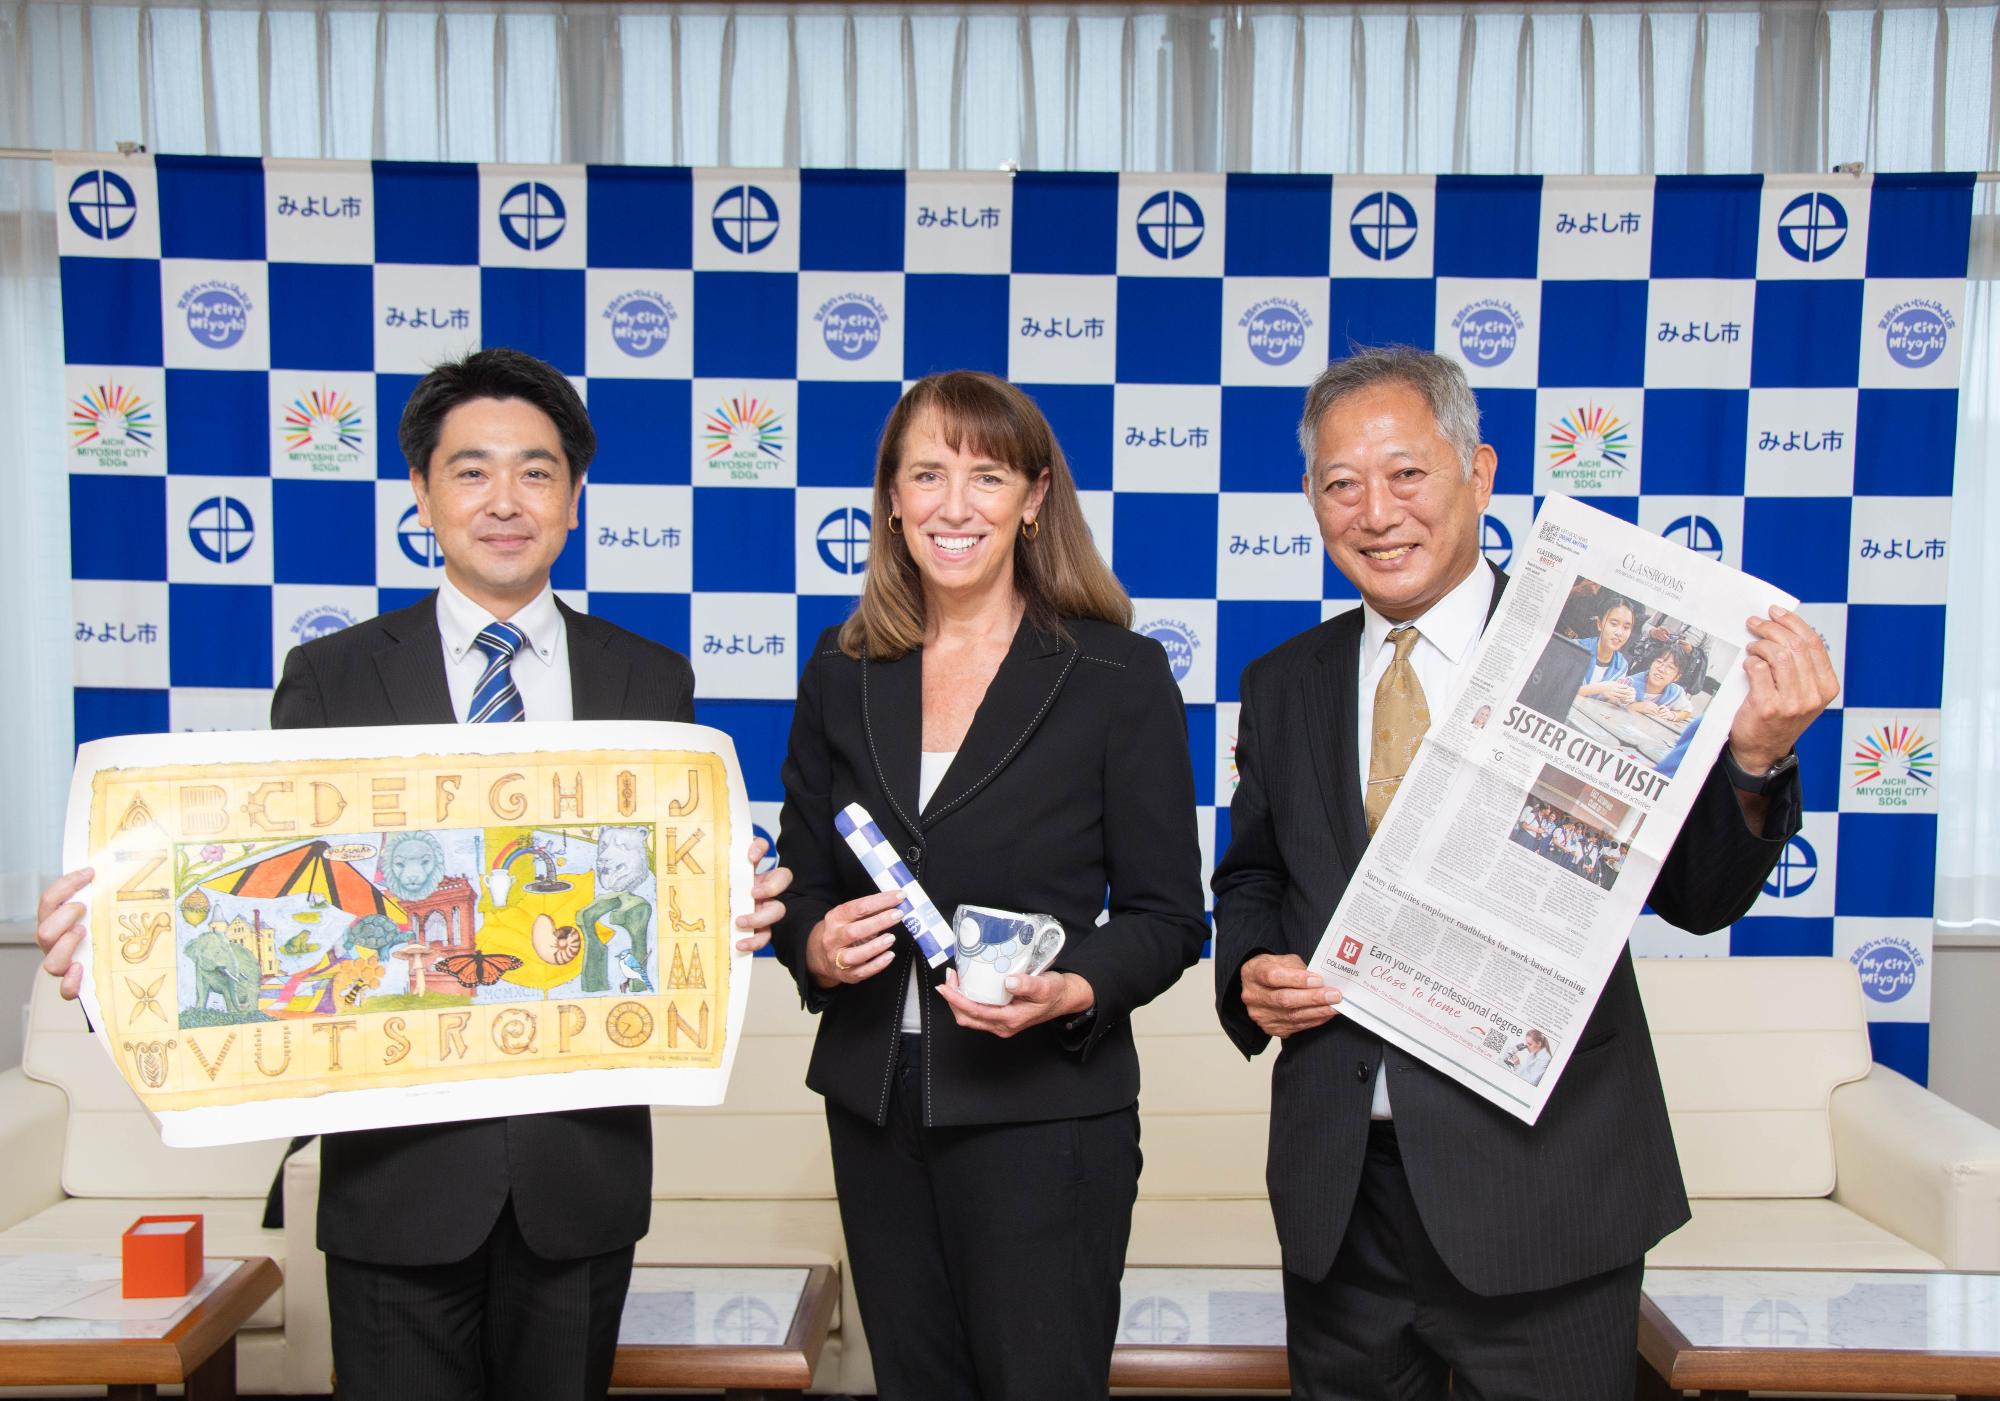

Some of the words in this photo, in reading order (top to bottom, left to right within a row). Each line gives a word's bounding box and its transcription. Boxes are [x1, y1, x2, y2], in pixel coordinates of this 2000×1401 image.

[278, 196, 361, 218] みよし市
[917, 207, 1000, 228] みよし市
[1556, 212, 1641, 234] みよし市
[386, 308, 469, 329] みよし市
[1021, 317, 1104, 339] みよし市
[1658, 322, 1741, 344] みよし市
[1125, 427, 1209, 448] みよし市
[1759, 430, 1844, 452] みよし市
[78, 448, 121, 457] MIYOSHI
[124, 449, 148, 458] CITY
[99, 458, 128, 467] SDGs
[289, 453, 334, 461] MIYOSHI
[337, 454, 358, 462] CITY
[312, 464, 340, 472] SDGs
[756, 461, 778, 469] CITY
[1552, 470, 1596, 478] MIYOSHI
[1599, 470, 1622, 478] CITY
[1578, 460, 1600, 468] AICHI
[731, 471, 758, 479] SDGs
[1574, 480, 1602, 488] SDGs
[598, 528, 680, 548] みよし市
[1230, 534, 1312, 556] みよし市
[1861, 538, 1946, 560] みよし市
[75, 622, 157, 643] みよし市
[703, 634, 785, 655] みよし市
[1503, 706, 1567, 751] SISTER
[1567, 738, 1615, 773] CITY
[1614, 758, 1670, 801] VISIT
[180, 785, 230, 836] B
[239, 781, 294, 830] C
[310, 781, 346, 827] D
[372, 777, 407, 827] E
[435, 775, 461, 821] F
[489, 773, 527, 820] G
[553, 771, 583, 820] H
[668, 769, 699, 817] J
[1856, 788, 1902, 796] MIYOSHI
[1904, 788, 1928, 796] CITY
[1878, 797, 1907, 806] SDGs
[667, 826, 705, 875] K
[115, 849, 168, 901] Z
[1365, 870, 1386, 889] Survey
[1387, 883, 1420, 905] identifies
[1422, 903, 1455, 924] employer
[1455, 921, 1496, 945] roadblocks
[1498, 942, 1509, 952] for
[1511, 950, 1553, 976] work-based
[1553, 971, 1586, 995] learning
[668, 943, 705, 990] M
[1326, 958, 1360, 977] COLUMBUS
[1368, 945, 1392, 964] Earn
[1391, 959, 1415, 975] your
[1413, 971, 1490, 1018] pre-professional
[1490, 1012, 1523, 1037] degree
[1371, 966, 1406, 990] Close
[1412, 987, 1423, 998] to
[1428, 990, 1461, 1017] home
[187, 1032, 237, 1082] V
[255, 1025, 290, 1077] U
[313, 1021, 357, 1070] T
[384, 1015, 410, 1065] S
[439, 1012, 472, 1061] R
[558, 1005, 585, 1053] P
[668, 1001, 706, 1050] N
